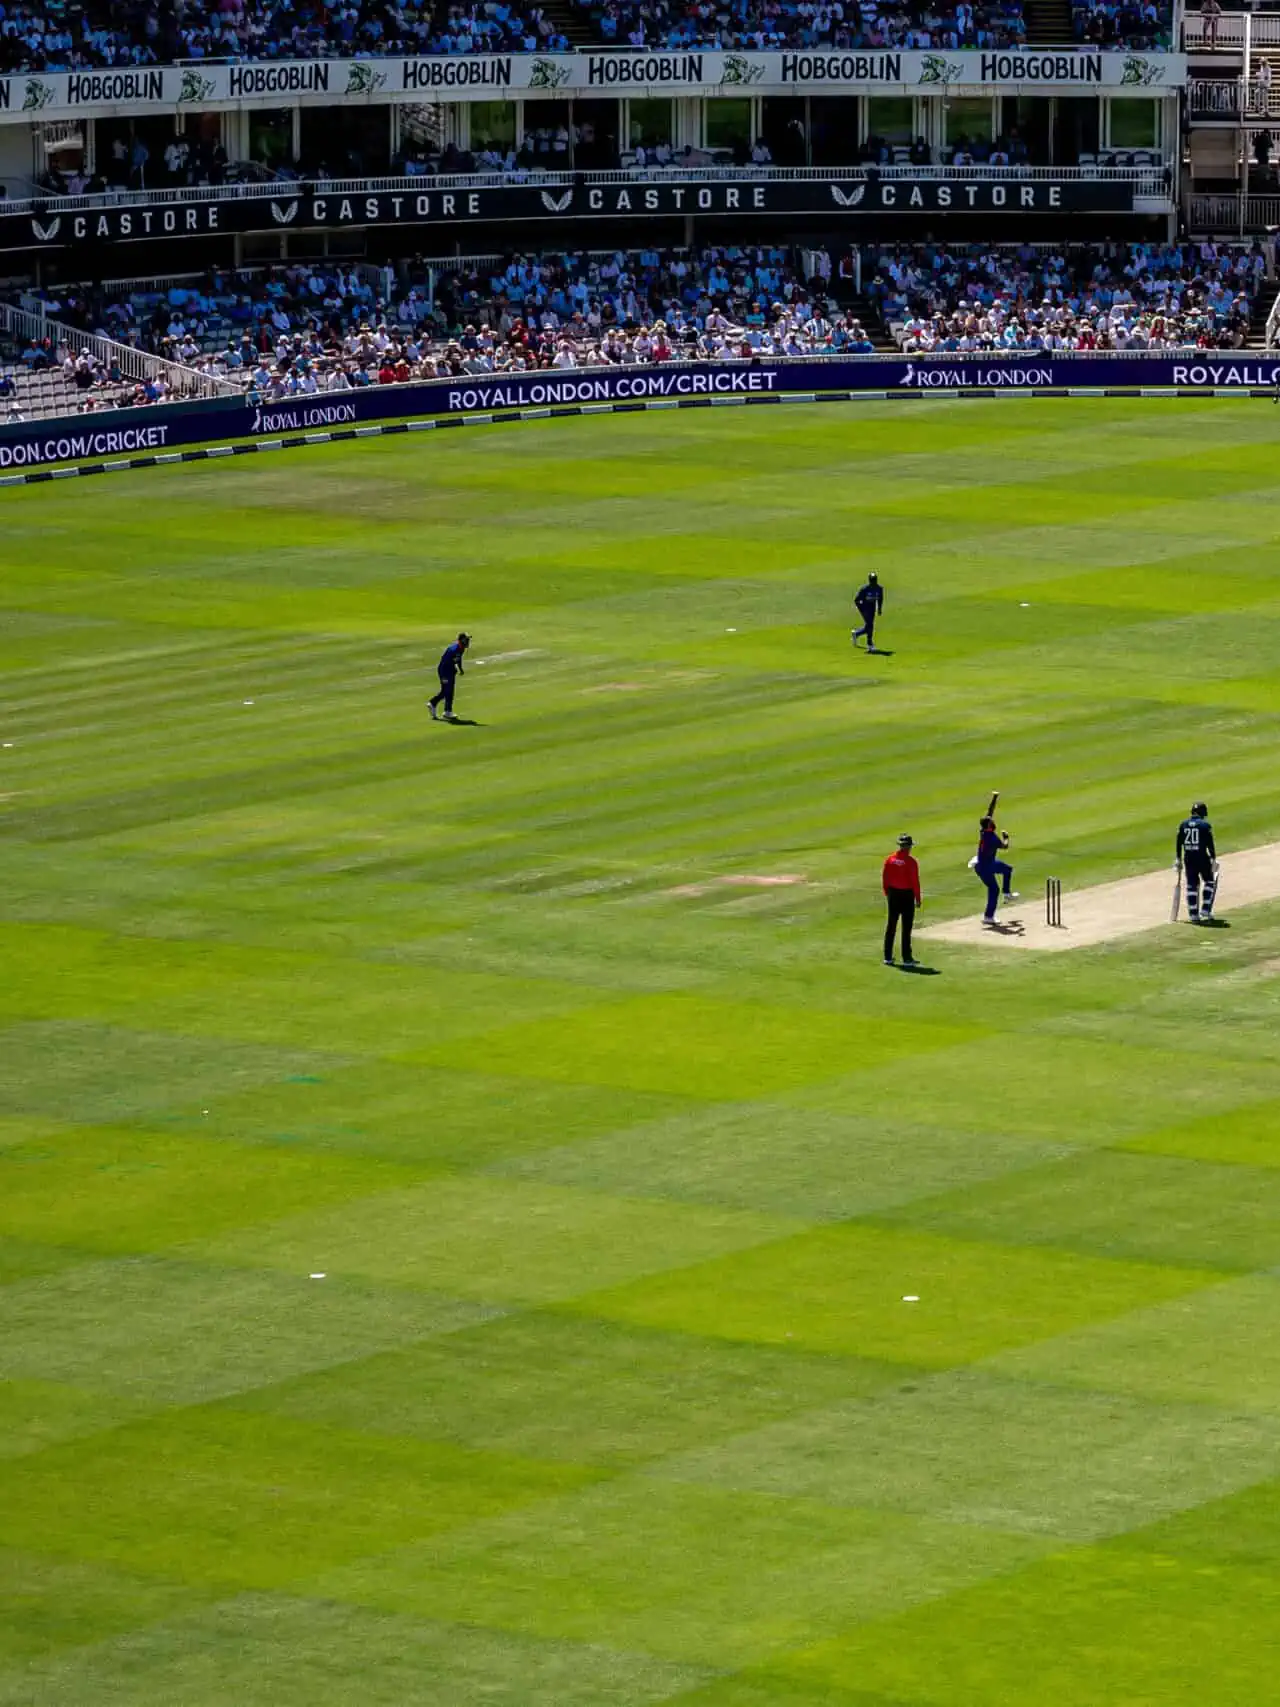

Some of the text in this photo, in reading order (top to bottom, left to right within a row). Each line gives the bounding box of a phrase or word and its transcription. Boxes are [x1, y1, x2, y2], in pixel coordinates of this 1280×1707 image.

[229, 63, 329, 97] HOBGOBLIN
[402, 58, 511, 90] HOBGOBLIN
[588, 55, 702, 84] HOBGOBLIN
[780, 53, 900, 82] HOBGOBLIN
[980, 53, 1101, 82] HOBGOBLIN
[67, 70, 163, 104] HOBGOBLIN
[312, 194, 481, 222] CASTORE
[588, 187, 766, 211] CASTORE
[882, 185, 1062, 208] CASTORE
[74, 207, 219, 238] CASTORE
[448, 371, 778, 409] ROYALLONDON.COM/CRICKET
[917, 369, 1053, 387] ROYAL LONDON
[262, 404, 356, 432] ROYAL LONDON
[1184, 827, 1200, 845] 20
